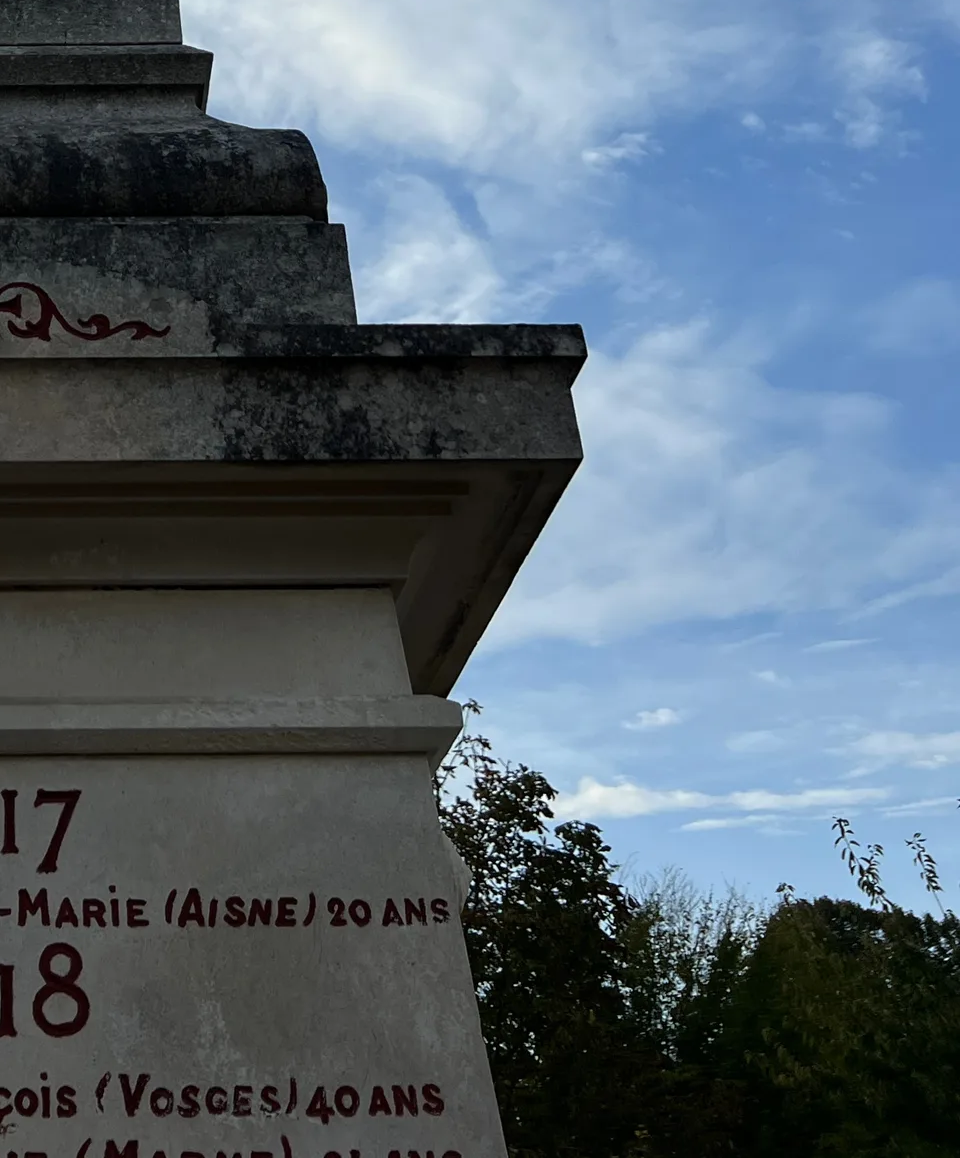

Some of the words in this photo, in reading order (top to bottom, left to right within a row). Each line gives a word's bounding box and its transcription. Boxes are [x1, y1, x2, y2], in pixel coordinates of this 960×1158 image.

[326, 897, 373, 929] 20
[381, 896, 452, 926] ANS
[368, 1084, 446, 1119] ANS
